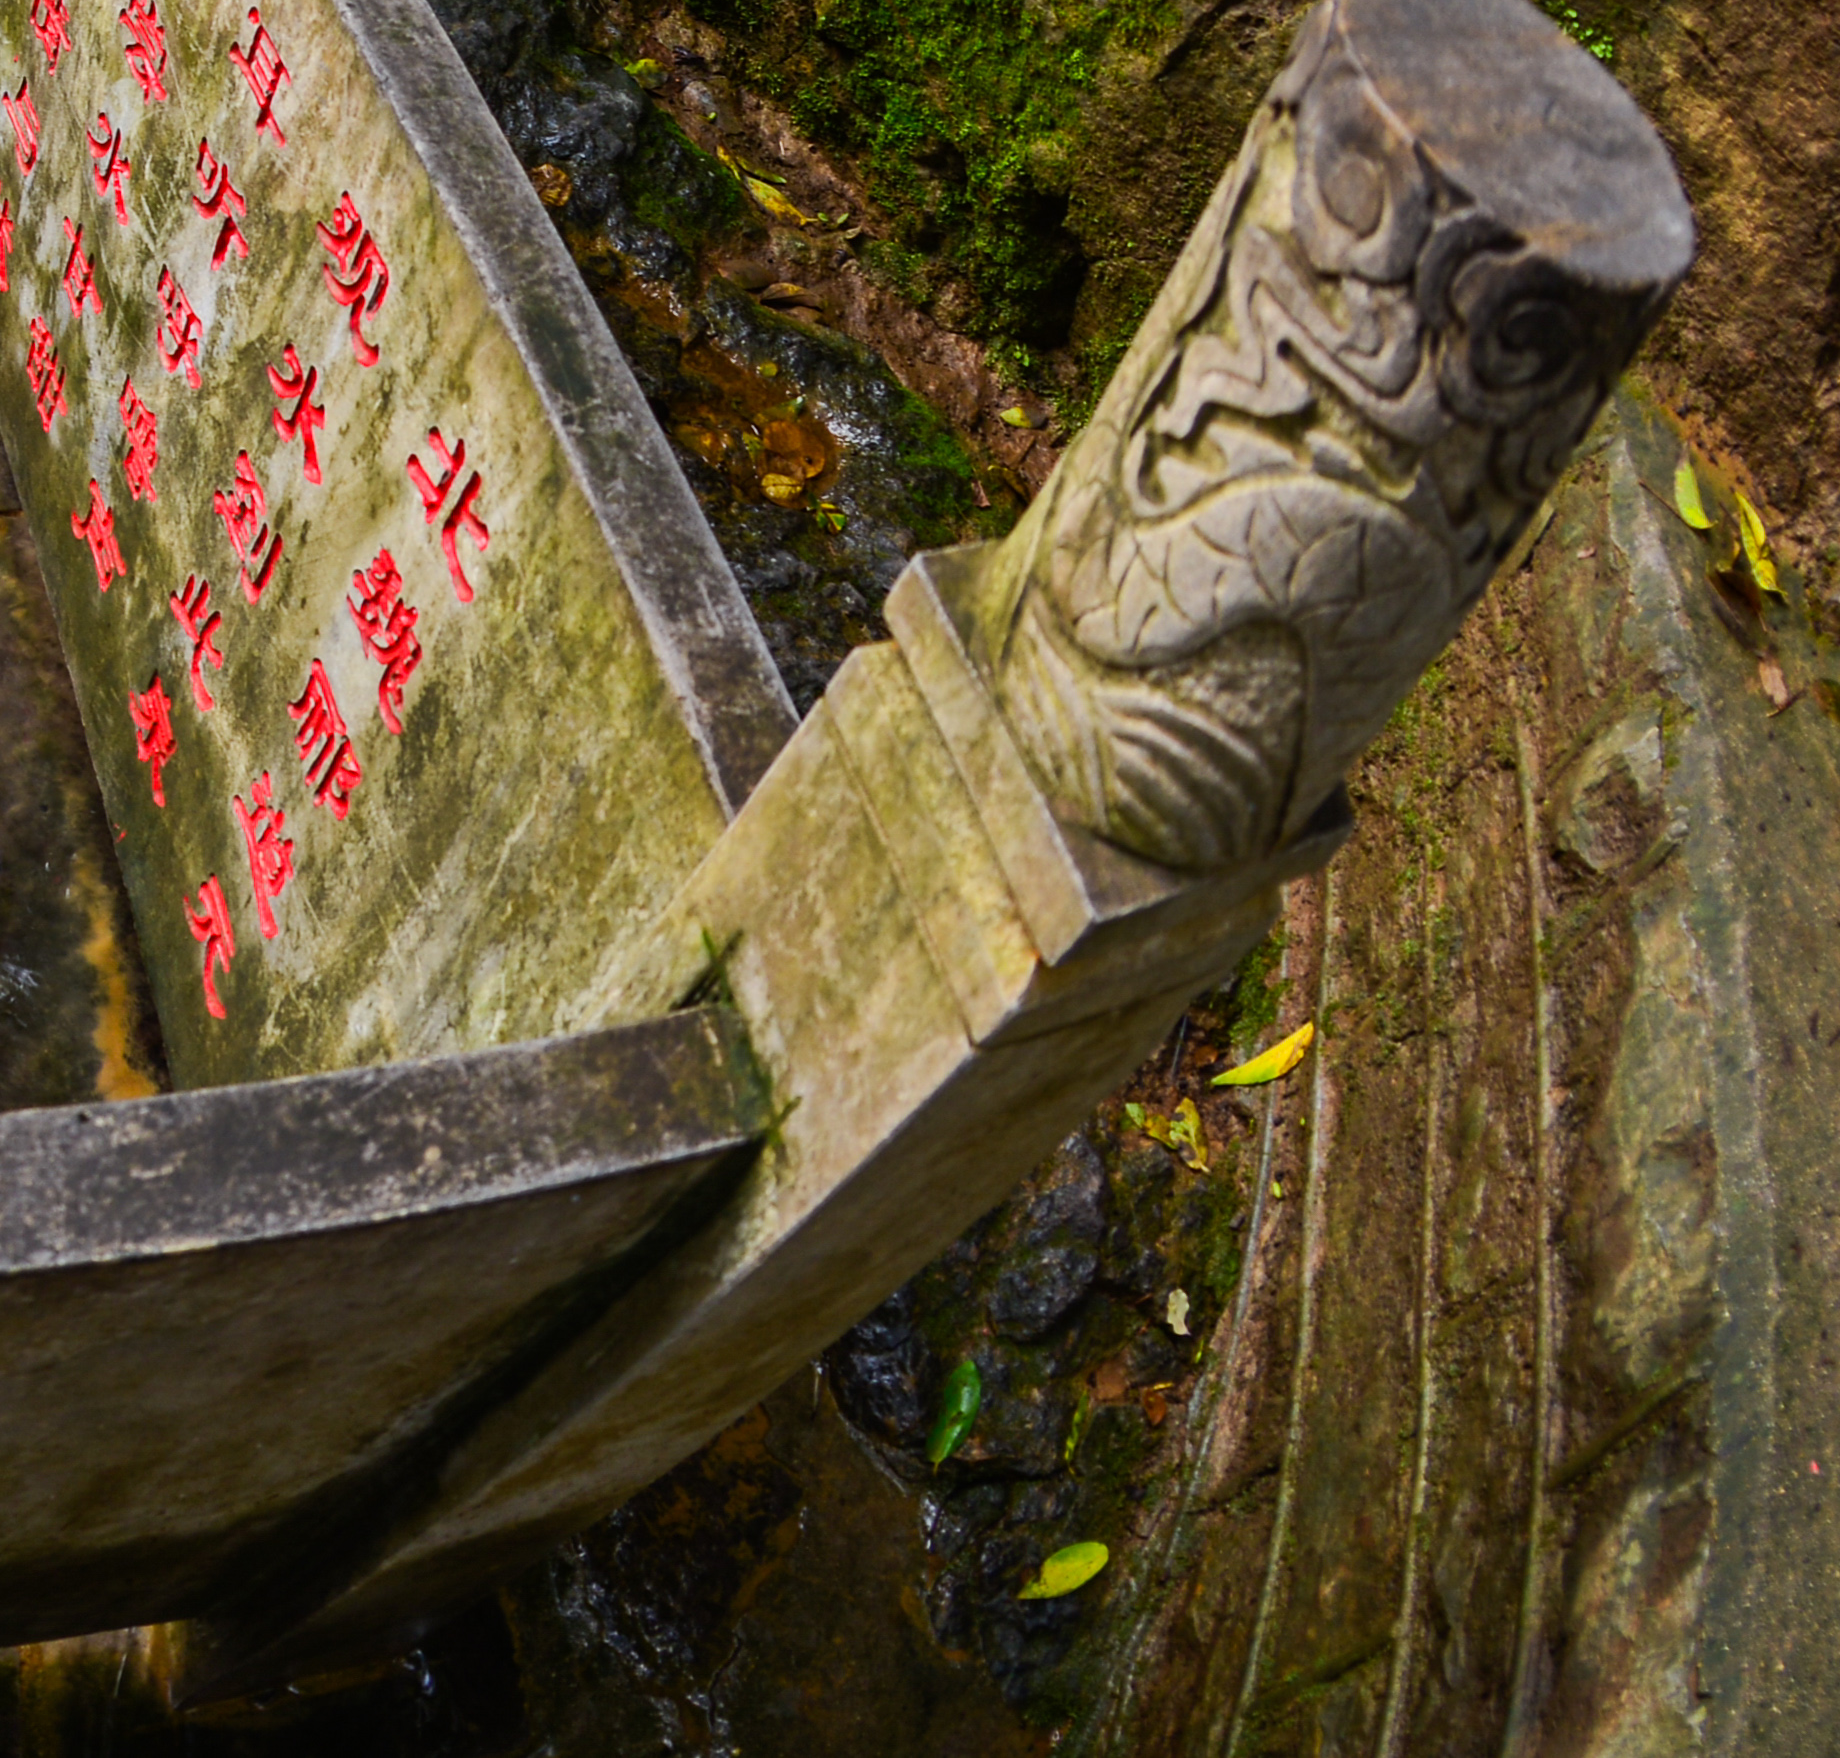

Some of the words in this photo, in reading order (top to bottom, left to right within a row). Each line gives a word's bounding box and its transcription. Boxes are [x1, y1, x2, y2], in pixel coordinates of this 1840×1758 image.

[70, 6, 292, 594] 耳听呼噜声
[127, 190, 390, 809] 观水到此泉
[183, 426, 492, 1020] 北魏郦道元
